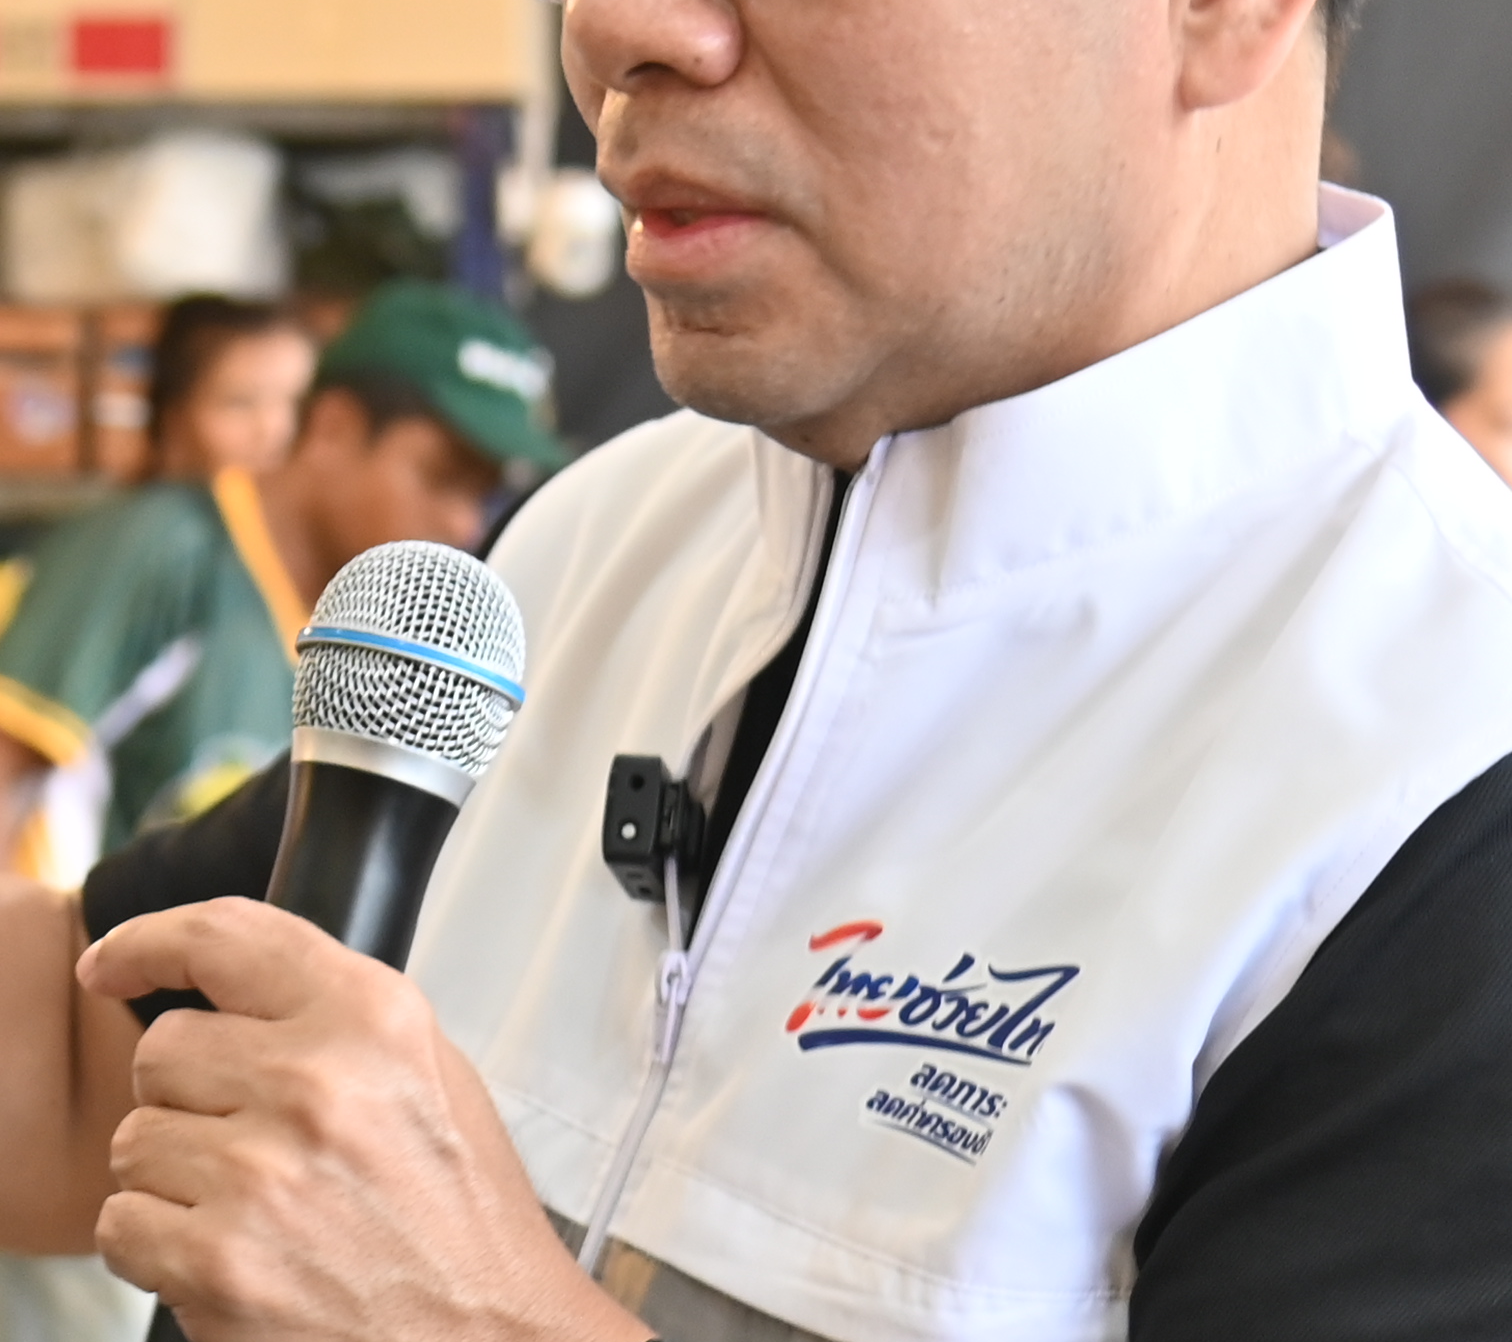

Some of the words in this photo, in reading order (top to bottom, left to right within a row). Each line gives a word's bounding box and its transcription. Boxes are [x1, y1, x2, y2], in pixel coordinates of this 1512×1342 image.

[784, 919, 1080, 1057] ไทยช่วยไท
[909, 1061, 1008, 1120] ลดภาระ
